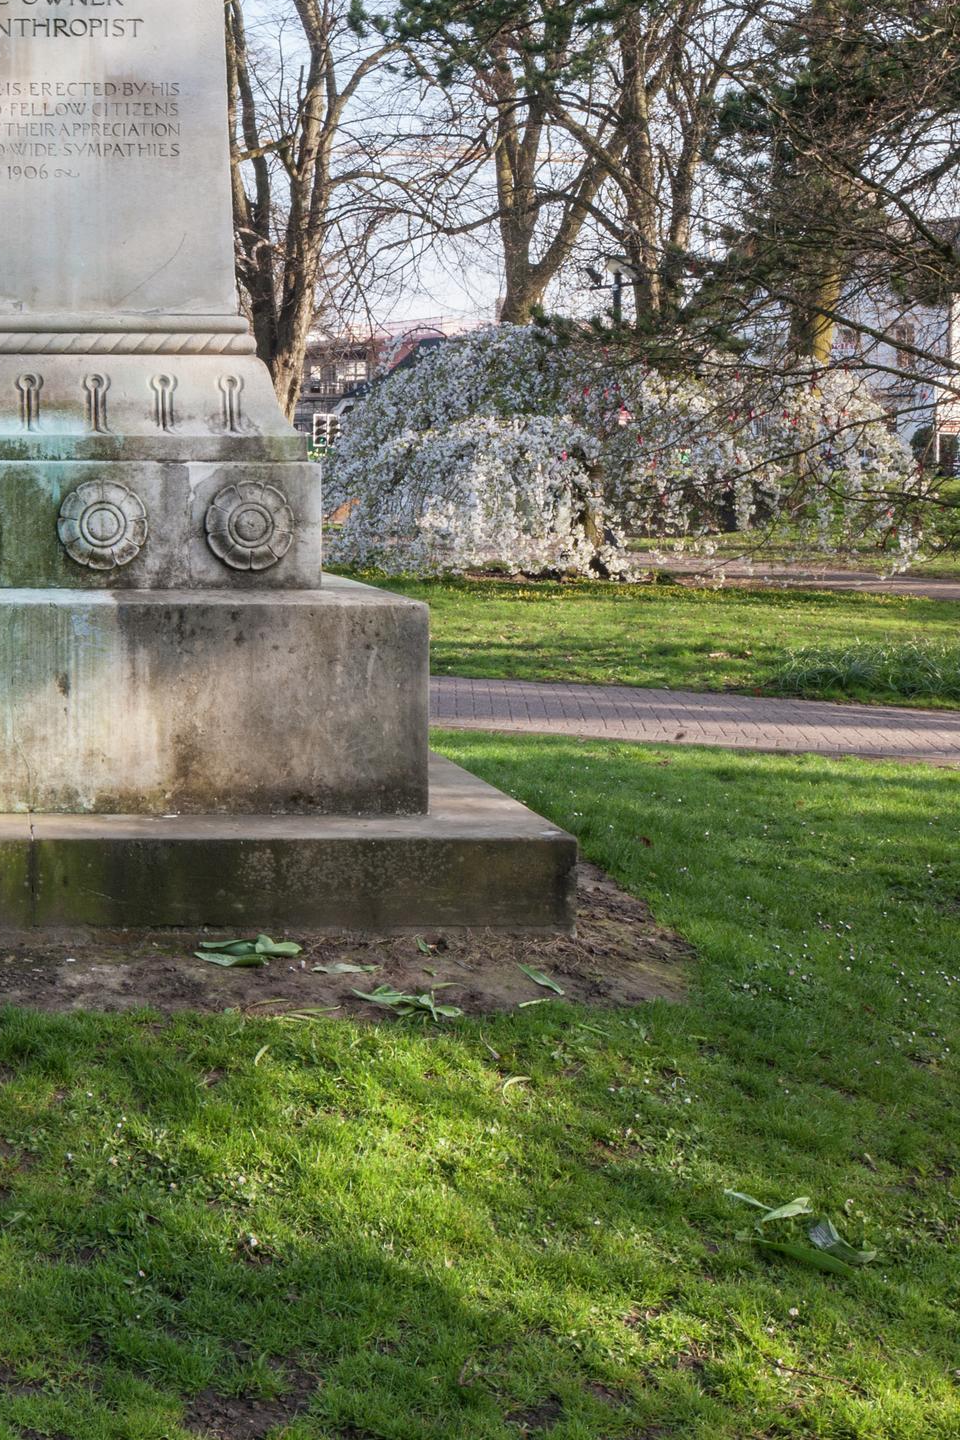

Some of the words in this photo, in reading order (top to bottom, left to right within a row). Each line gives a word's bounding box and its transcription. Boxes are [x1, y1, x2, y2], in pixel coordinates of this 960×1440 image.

[6, 82, 22, 96] IS
[29, 82, 117, 97] ERECTED
[122, 82, 147, 97] BY
[151, 82, 180, 97] HIS
[10, 102, 87, 117] FELLOW
[92, 102, 179, 117] CITIZENS
[3, 122, 55, 137] THEIR
[58, 122, 181, 137] APPRECIATION
[9, 143, 57, 157] WIDE
[63, 143, 181, 157] SYMPATHIES
[7, 163, 49, 180] 1906
